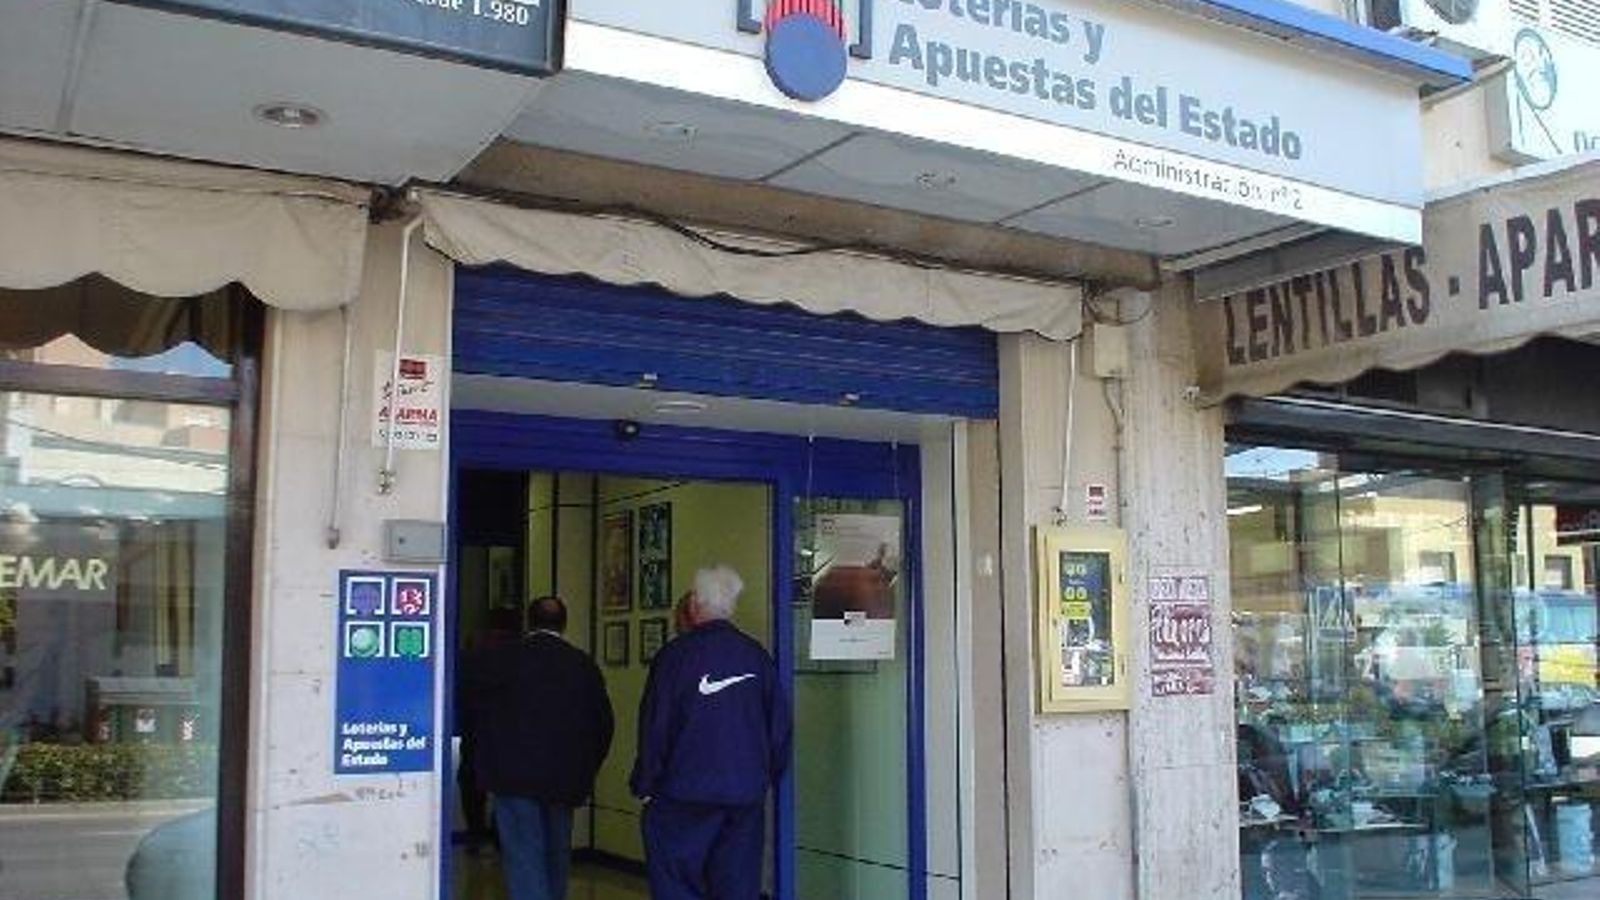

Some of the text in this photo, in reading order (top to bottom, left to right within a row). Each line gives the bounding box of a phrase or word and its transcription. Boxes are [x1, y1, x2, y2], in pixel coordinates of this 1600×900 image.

[473, 0, 529, 26] 1.980
[891, 0, 1105, 65] erias y
[888, 23, 1303, 160] Apuestas del Estado
[1223, 248, 1430, 366] LENTILLAS
[1479, 199, 1600, 310] APAR
[378, 406, 438, 422] AARMA
[0, 555, 108, 590] EMAR
[398, 722, 408, 737] y
[342, 736, 426, 752] Apuestas del
[340, 752, 388, 767] Estado
